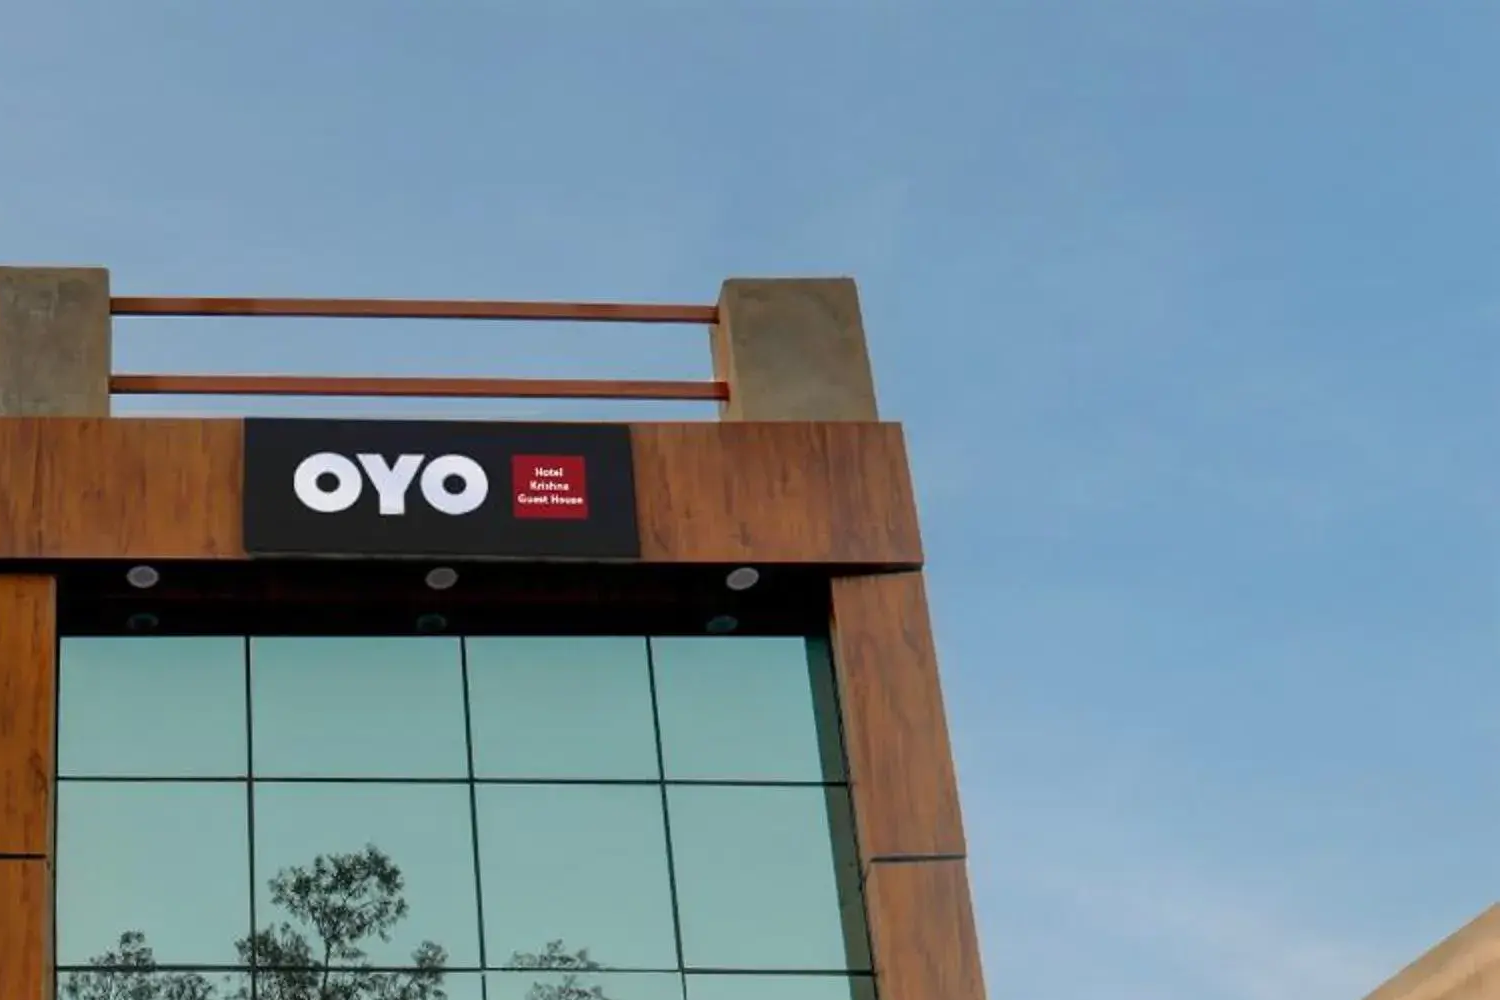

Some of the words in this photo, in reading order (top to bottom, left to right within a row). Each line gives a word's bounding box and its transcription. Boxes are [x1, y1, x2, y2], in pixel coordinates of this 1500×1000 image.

[535, 467, 563, 477] Hotel
[294, 451, 488, 515] OYO
[530, 481, 569, 491] Krishna
[517, 493, 547, 504] Guest
[551, 494, 583, 504] House
